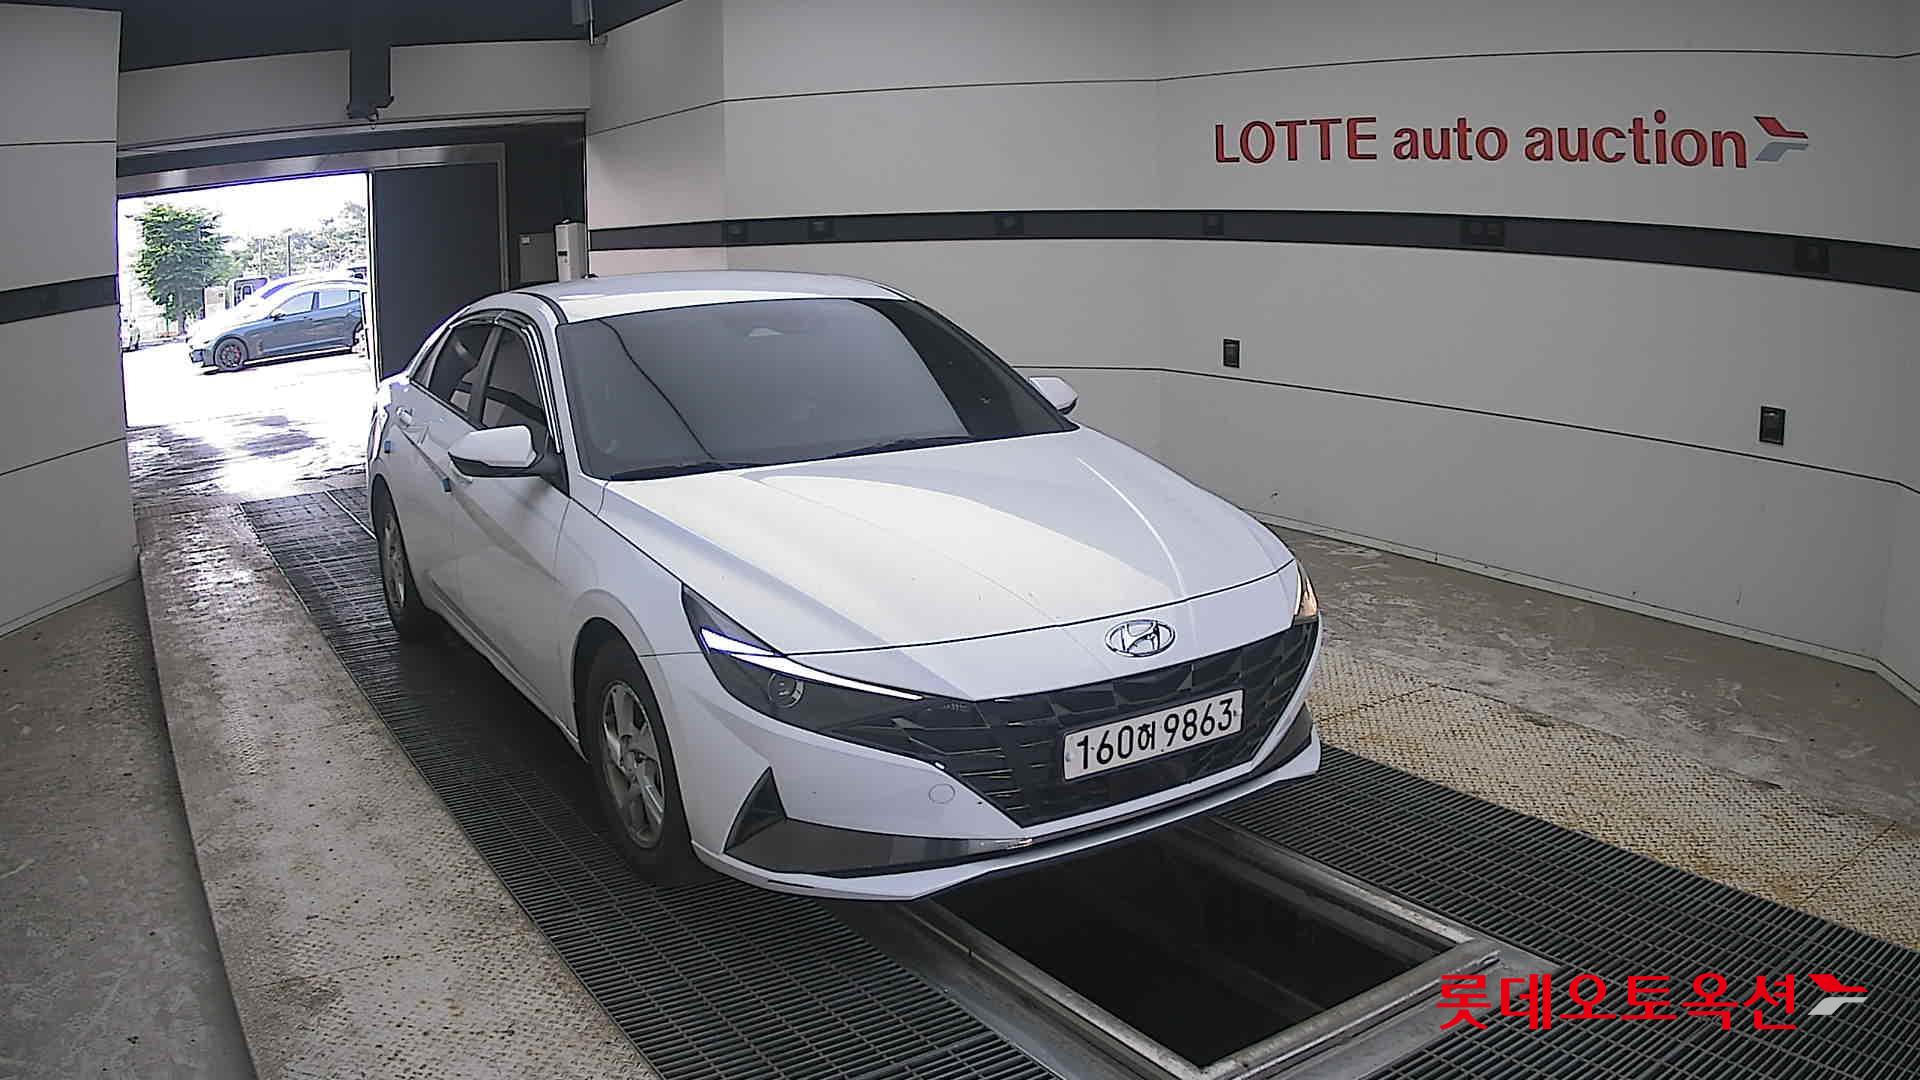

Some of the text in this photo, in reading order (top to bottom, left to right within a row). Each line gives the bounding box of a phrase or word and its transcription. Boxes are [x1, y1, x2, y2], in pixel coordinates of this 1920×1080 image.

[1214, 109, 1748, 169] LOTTE auto auction
[1163, 697, 1234, 748] 9863
